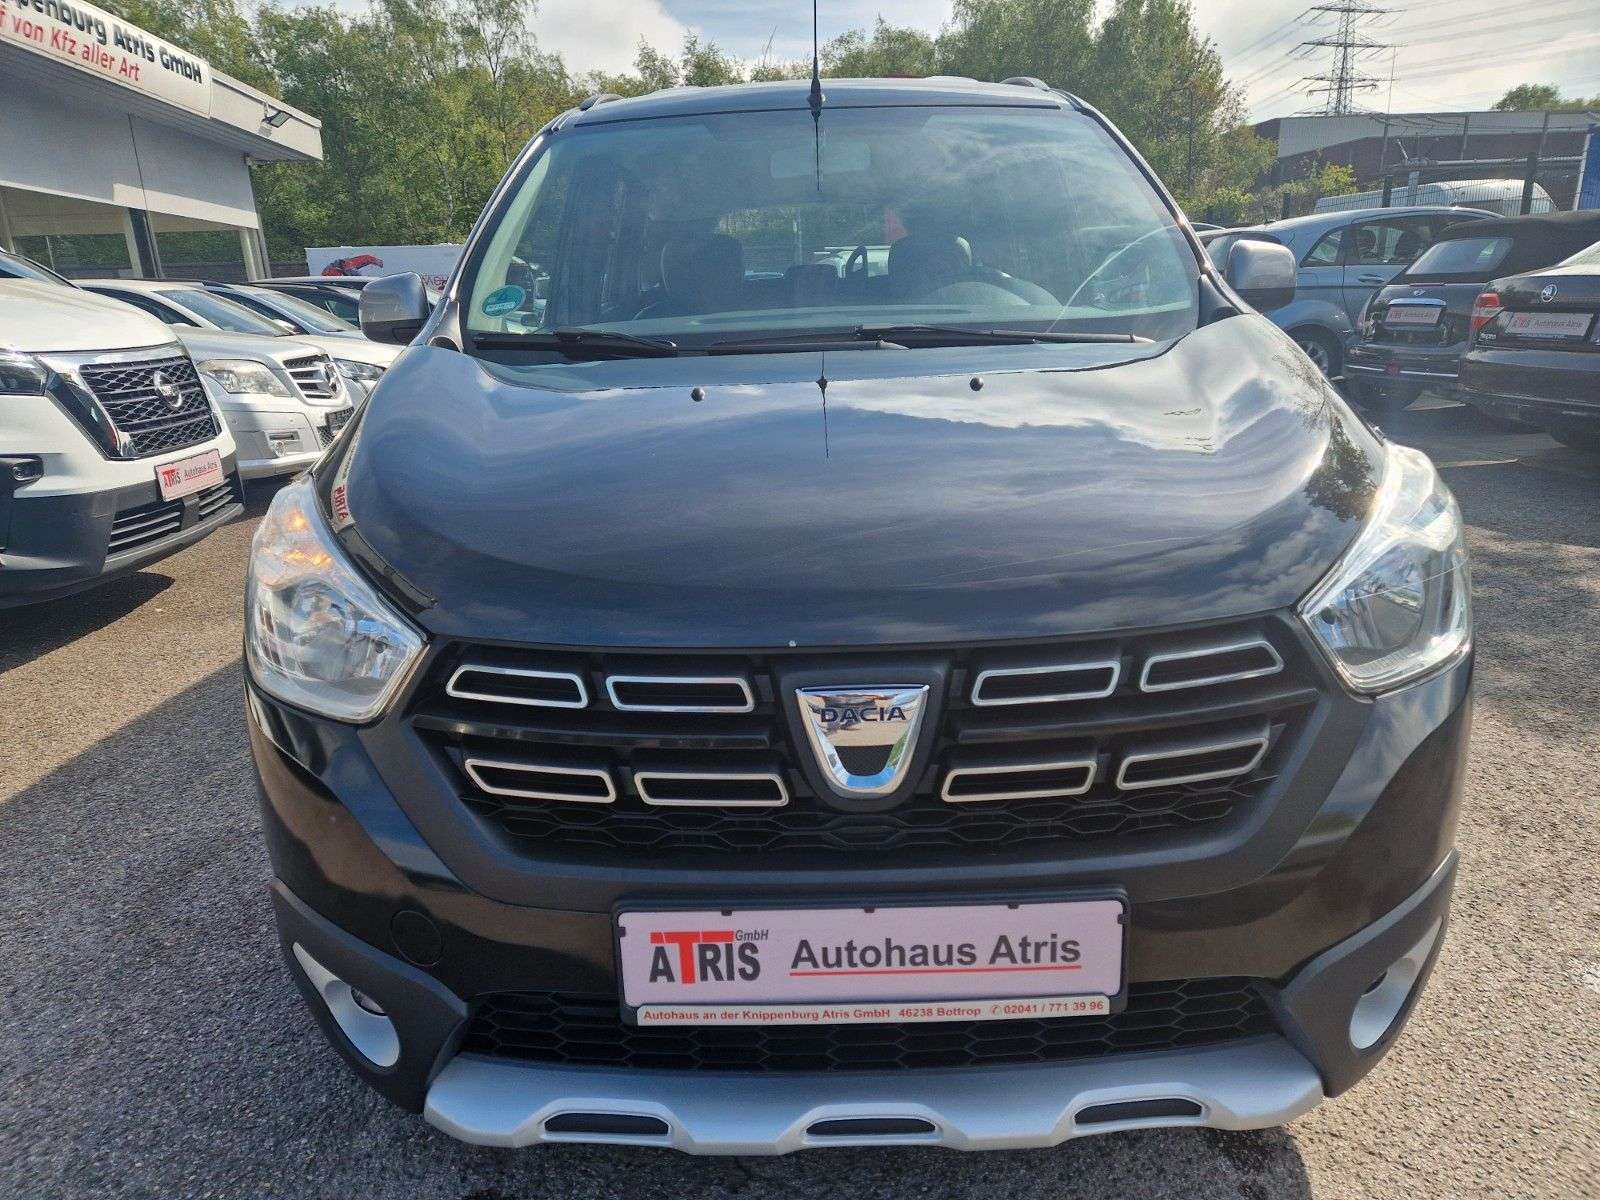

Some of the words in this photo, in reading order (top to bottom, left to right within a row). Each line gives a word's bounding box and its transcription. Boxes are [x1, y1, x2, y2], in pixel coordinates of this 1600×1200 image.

[11, 15, 44, 43] von
[51, 27, 77, 56] Kfz
[81, 43, 115, 70] aller
[119, 57, 140, 82] Art
[112, 23, 155, 63] Atris
[158, 46, 202, 84] GmbH
[820, 706, 907, 722] DACIA
[649, 930, 761, 984] ATRIS
[735, 930, 769, 941] GmbH
[791, 937, 977, 969] Autohaus
[989, 933, 1081, 965] Atris
[643, 1011, 699, 1021] Autohaus
[720, 1010, 739, 1020] der
[743, 1010, 819, 1022] Knippenburg
[822, 1009, 850, 1019] Atris
[854, 1008, 890, 1018] GmbH
[898, 1008, 933, 1017] 46238
[937, 1007, 981, 1018] Bottrop
[1004, 1004, 1038, 1014] 02041
[1049, 1003, 1068, 1012] 771
[1072, 1002, 1087, 1011] 39
[1090, 1001, 1104, 1010] 96
